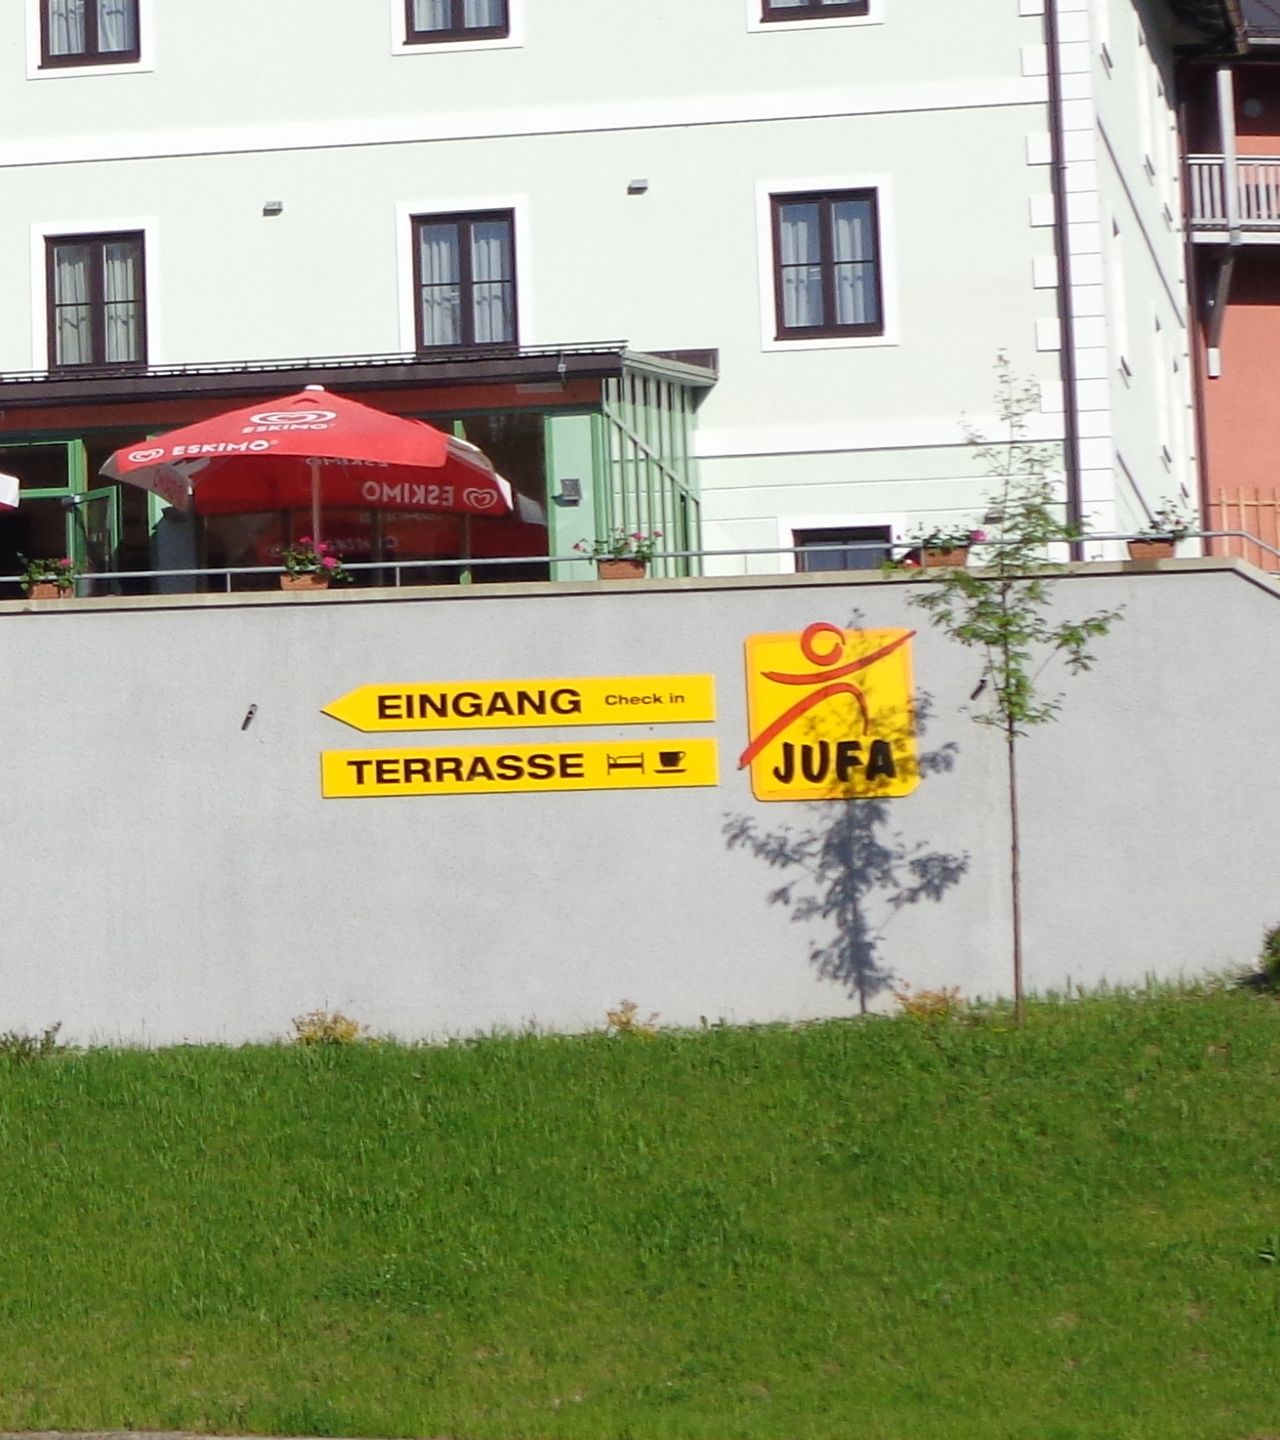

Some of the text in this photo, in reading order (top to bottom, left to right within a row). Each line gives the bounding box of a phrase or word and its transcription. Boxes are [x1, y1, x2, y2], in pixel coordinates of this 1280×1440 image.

[242, 423, 328, 434] ESKIMO
[172, 439, 270, 456] ESKIMO
[377, 688, 686, 720] EINGANG Check in
[346, 752, 585, 785] TERRASSE
[772, 739, 897, 784] JUFA
